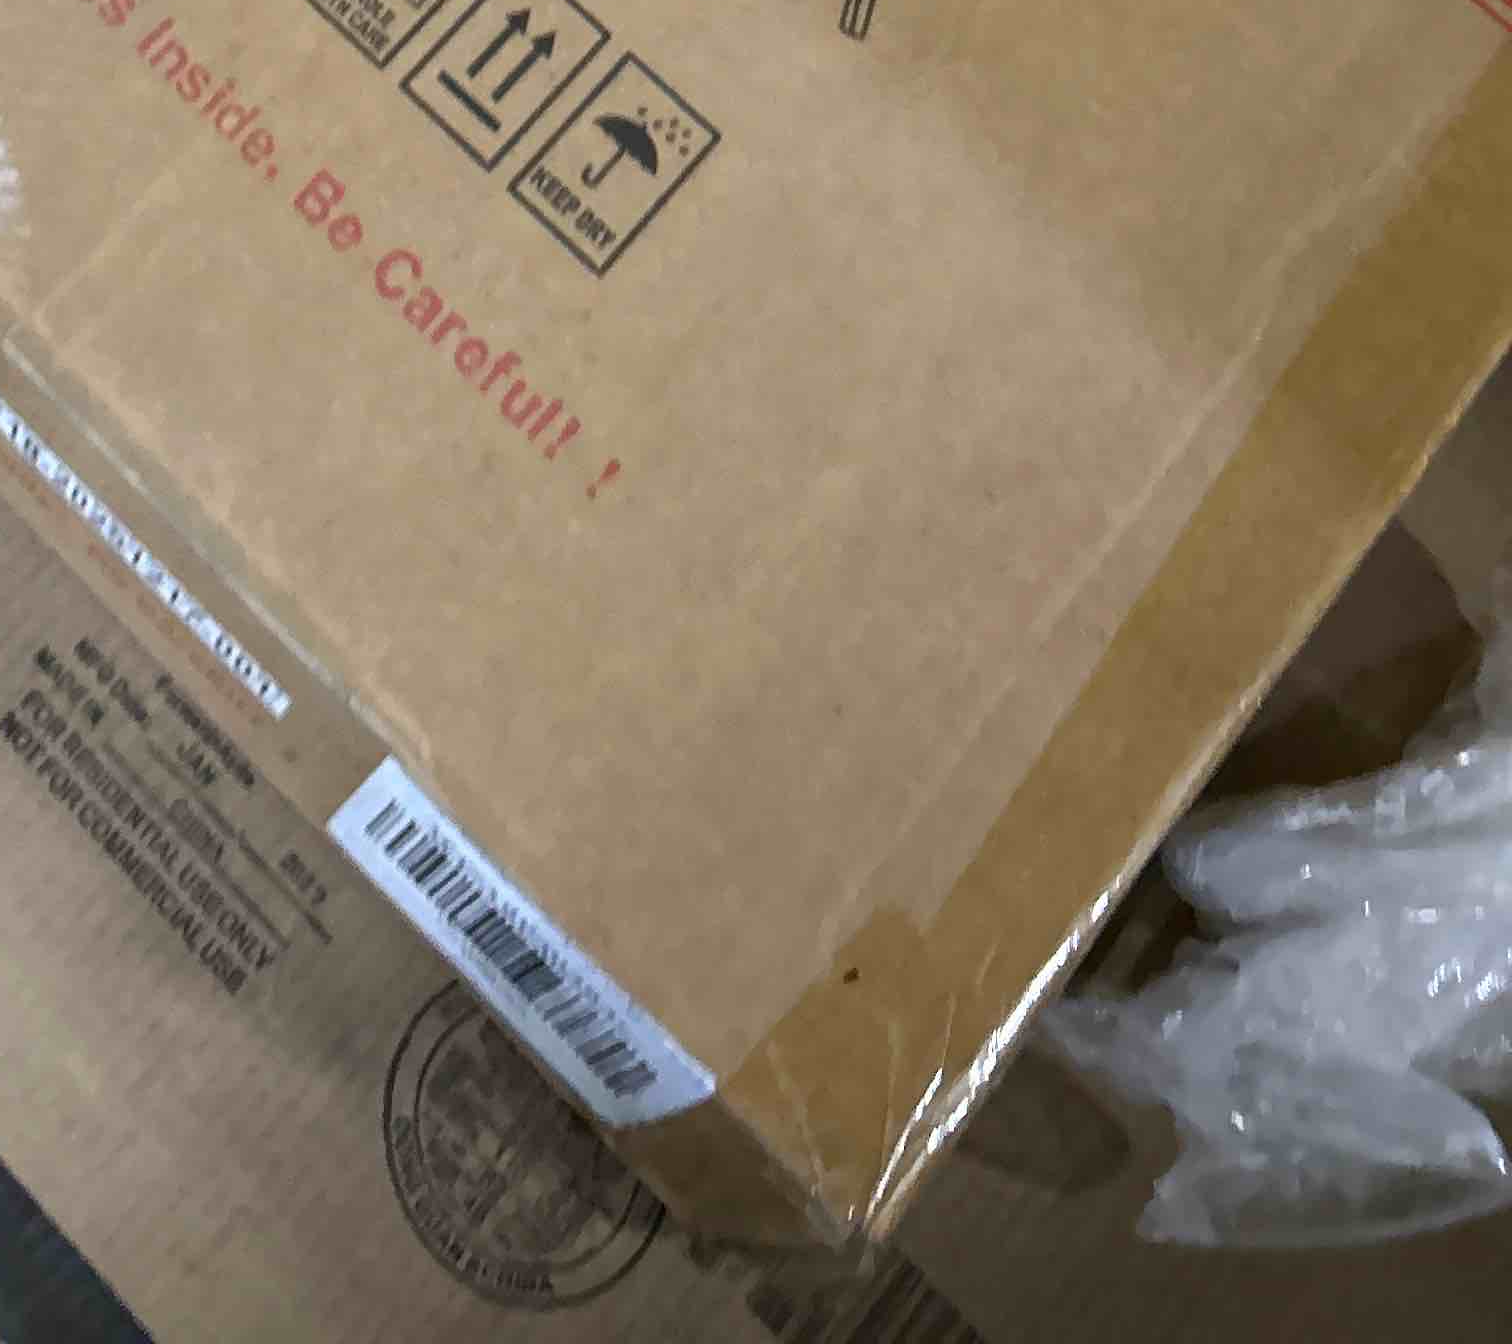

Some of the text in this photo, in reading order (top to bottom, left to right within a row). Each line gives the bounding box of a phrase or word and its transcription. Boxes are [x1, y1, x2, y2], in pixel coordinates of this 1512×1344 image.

[346, 9, 392, 54] CARE
[136, 16, 279, 181] Inside.
[291, 167, 366, 253] Be
[373, 246, 582, 463] Careful!
[527, 165, 619, 251] KEEP DRY
[19, 688, 275, 971] FOR RESIDENTIAL USE ONLY
[36, 754, 85, 810] FOR
[78, 804, 203, 952] COMMERCIAL
[199, 938, 248, 995] USE
